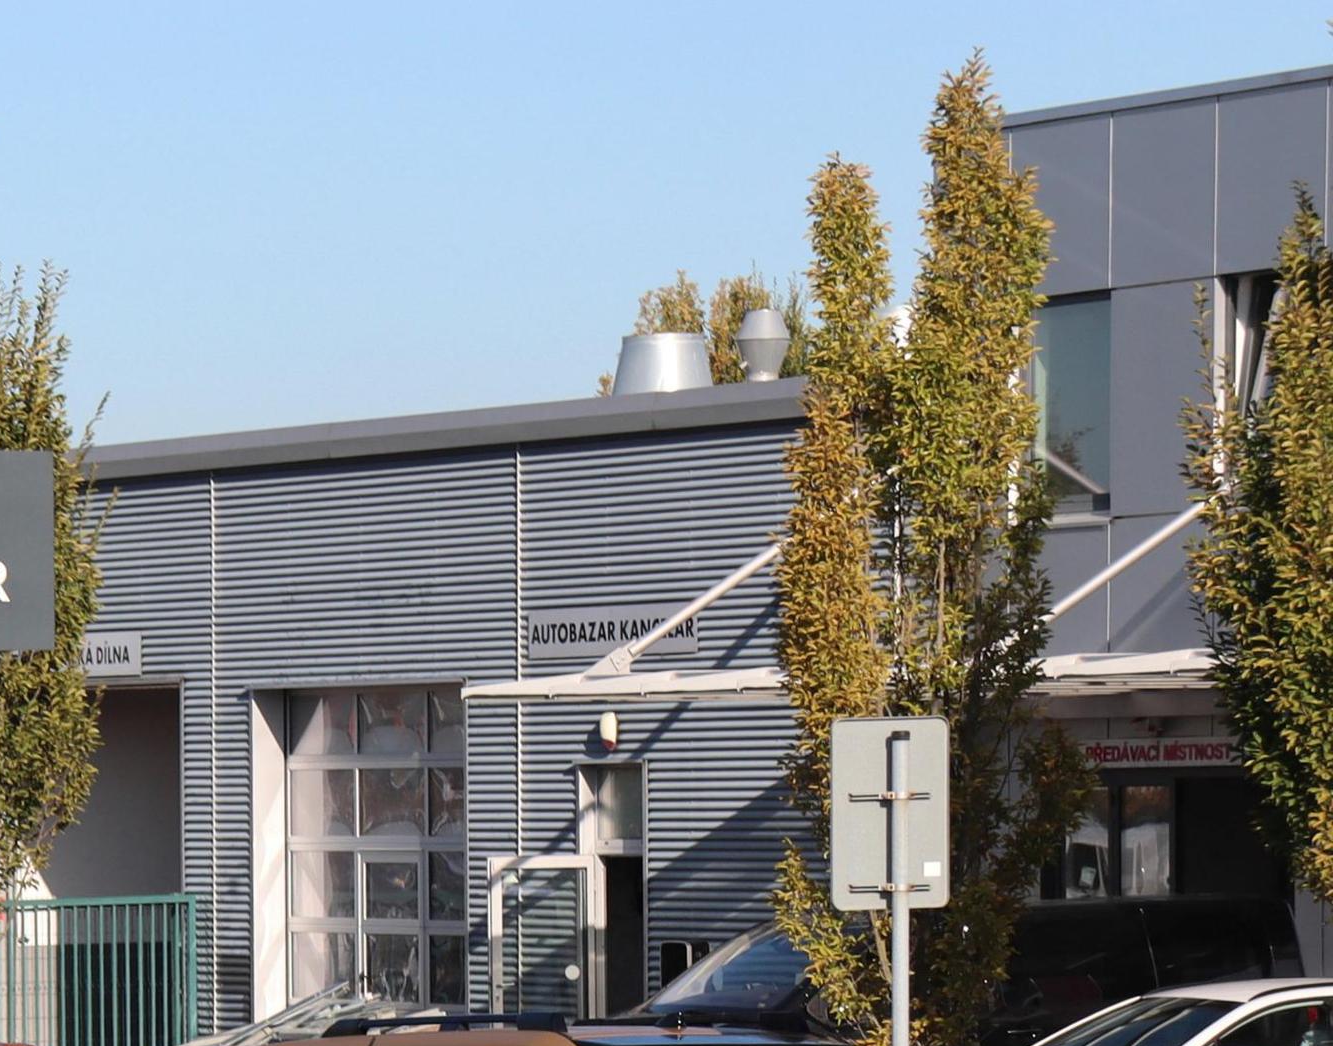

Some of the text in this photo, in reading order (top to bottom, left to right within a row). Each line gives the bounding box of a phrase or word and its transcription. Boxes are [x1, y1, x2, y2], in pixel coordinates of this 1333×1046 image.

[532, 620, 616, 644] AUTOBAZAR
[96, 640, 130, 664] DÍLNA
[1085, 739, 1232, 763] PŘEDÁVACÍ MÍSTNOST
